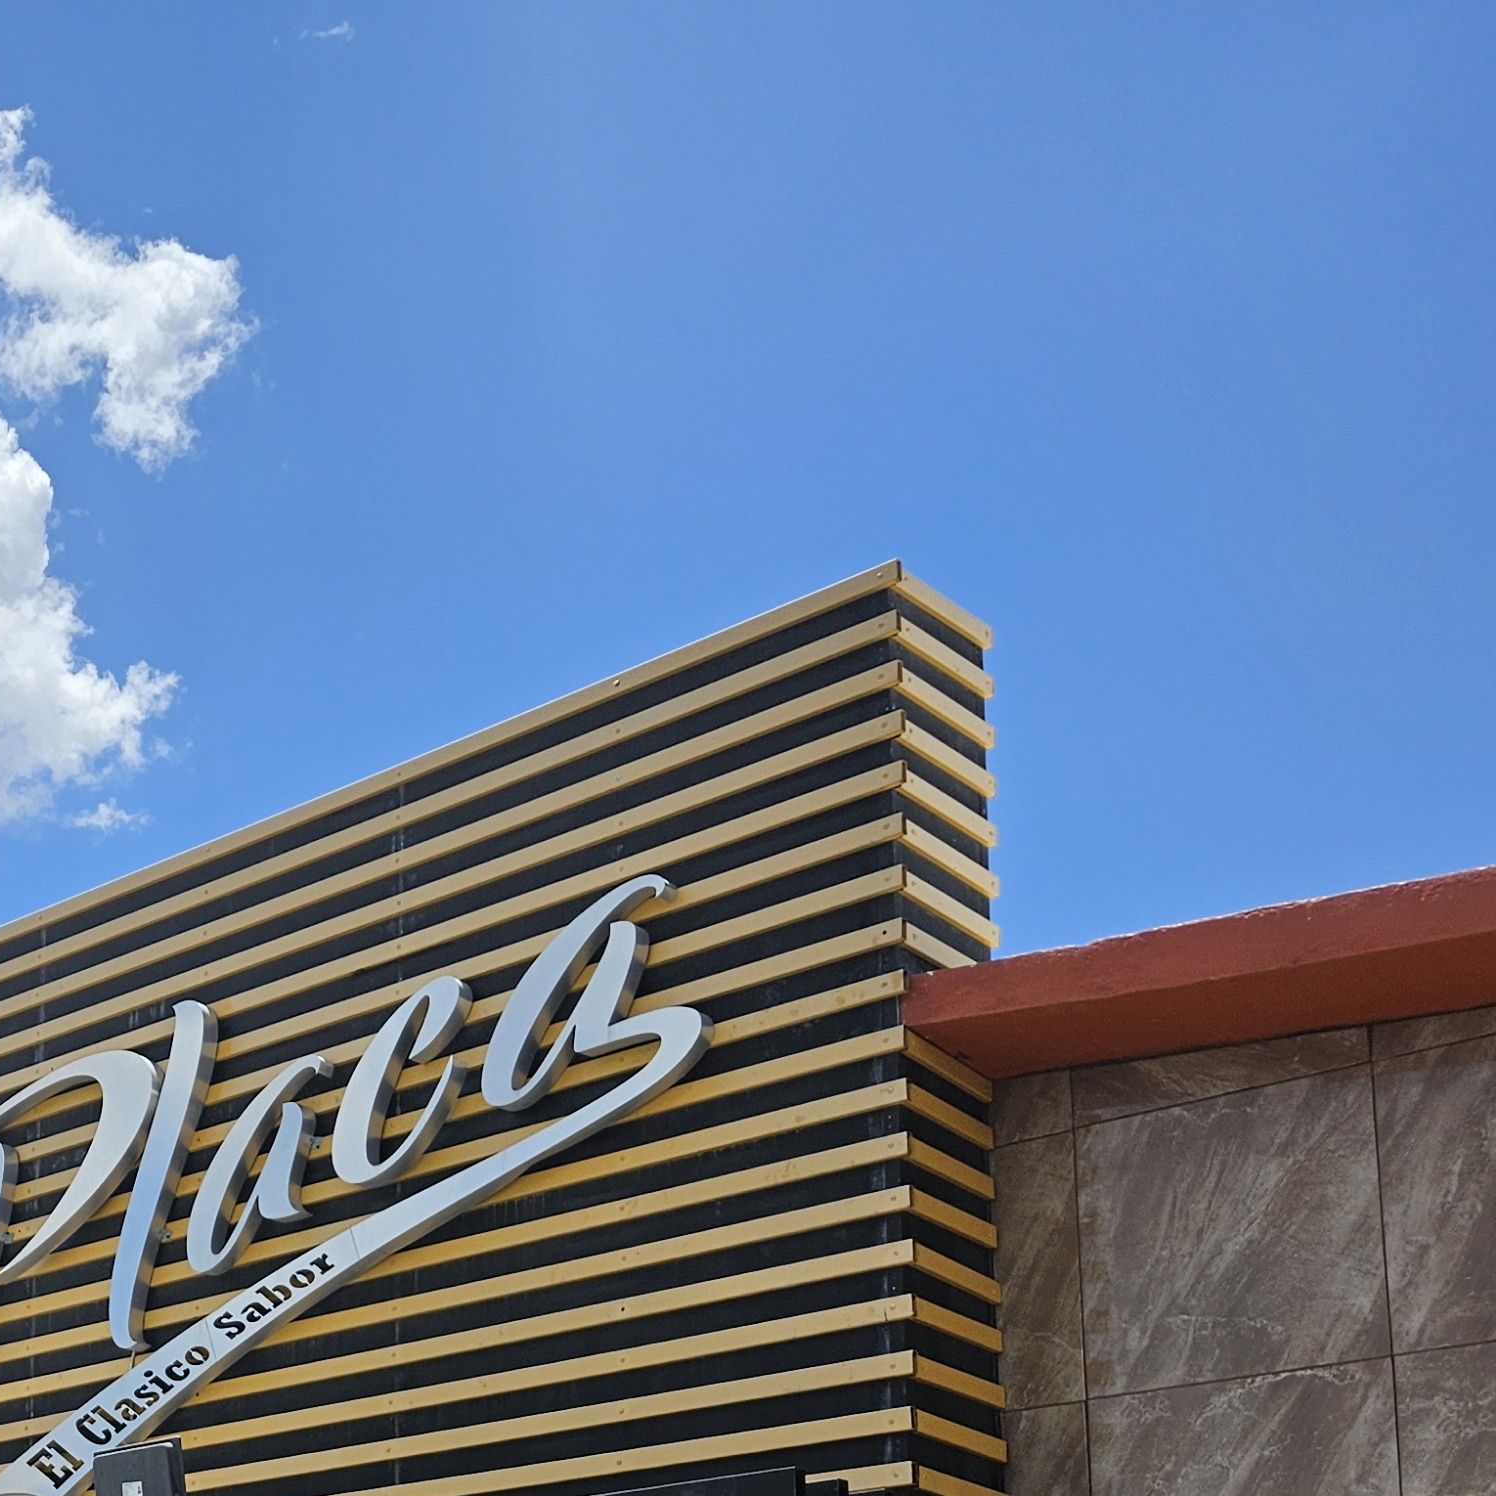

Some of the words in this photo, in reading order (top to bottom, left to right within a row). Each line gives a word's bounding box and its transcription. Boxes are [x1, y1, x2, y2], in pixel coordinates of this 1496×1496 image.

[26, 1439, 85, 1490] El
[74, 1345, 210, 1446] Clasico
[212, 1252, 335, 1340] Sabor
